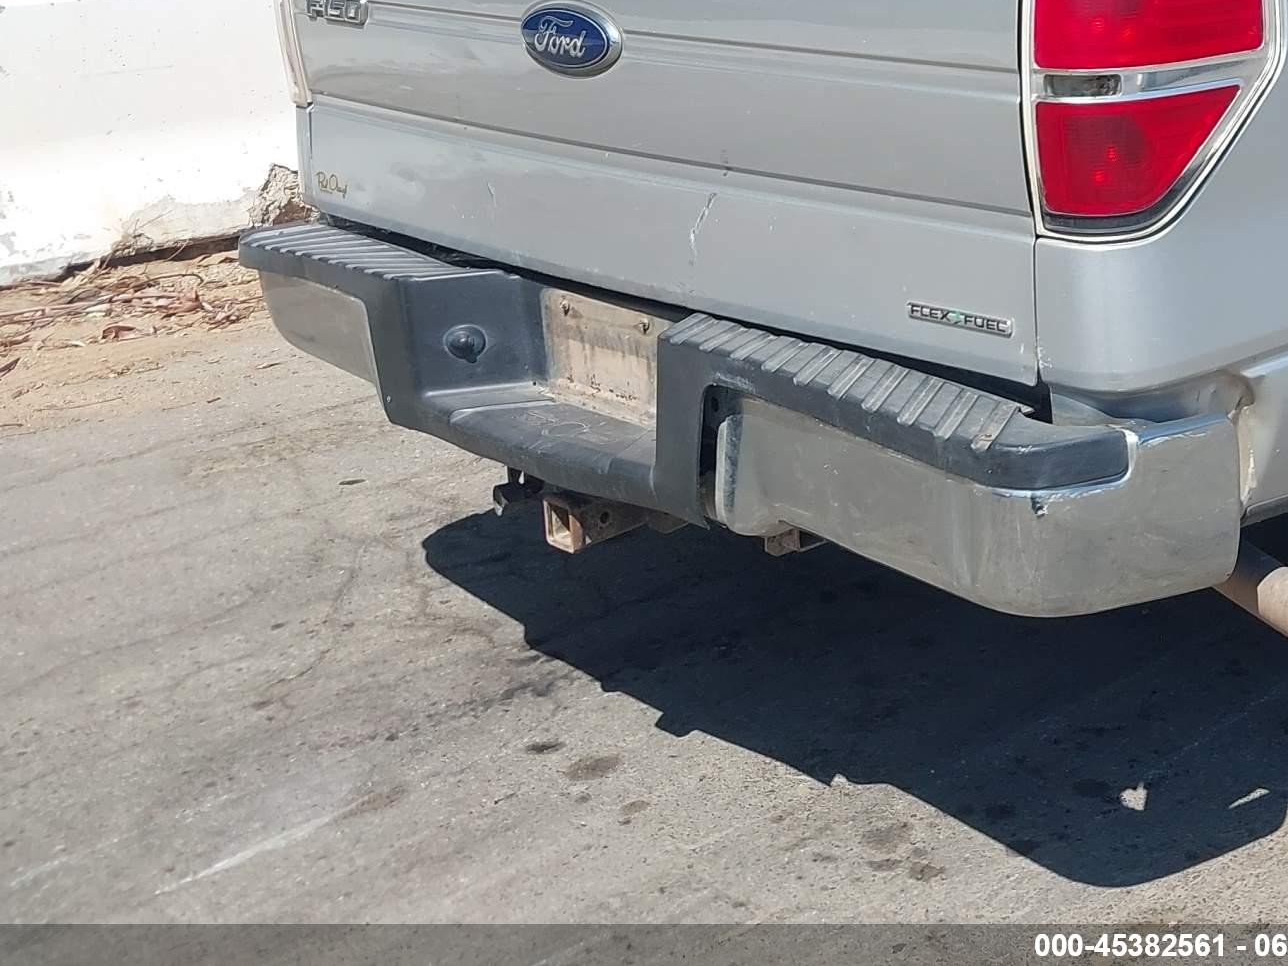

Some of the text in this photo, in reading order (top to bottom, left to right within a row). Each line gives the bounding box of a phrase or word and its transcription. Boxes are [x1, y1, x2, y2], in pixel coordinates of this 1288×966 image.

[534, 15, 586, 58] Ford
[910, 304, 1008, 333] FLEX FUEL
